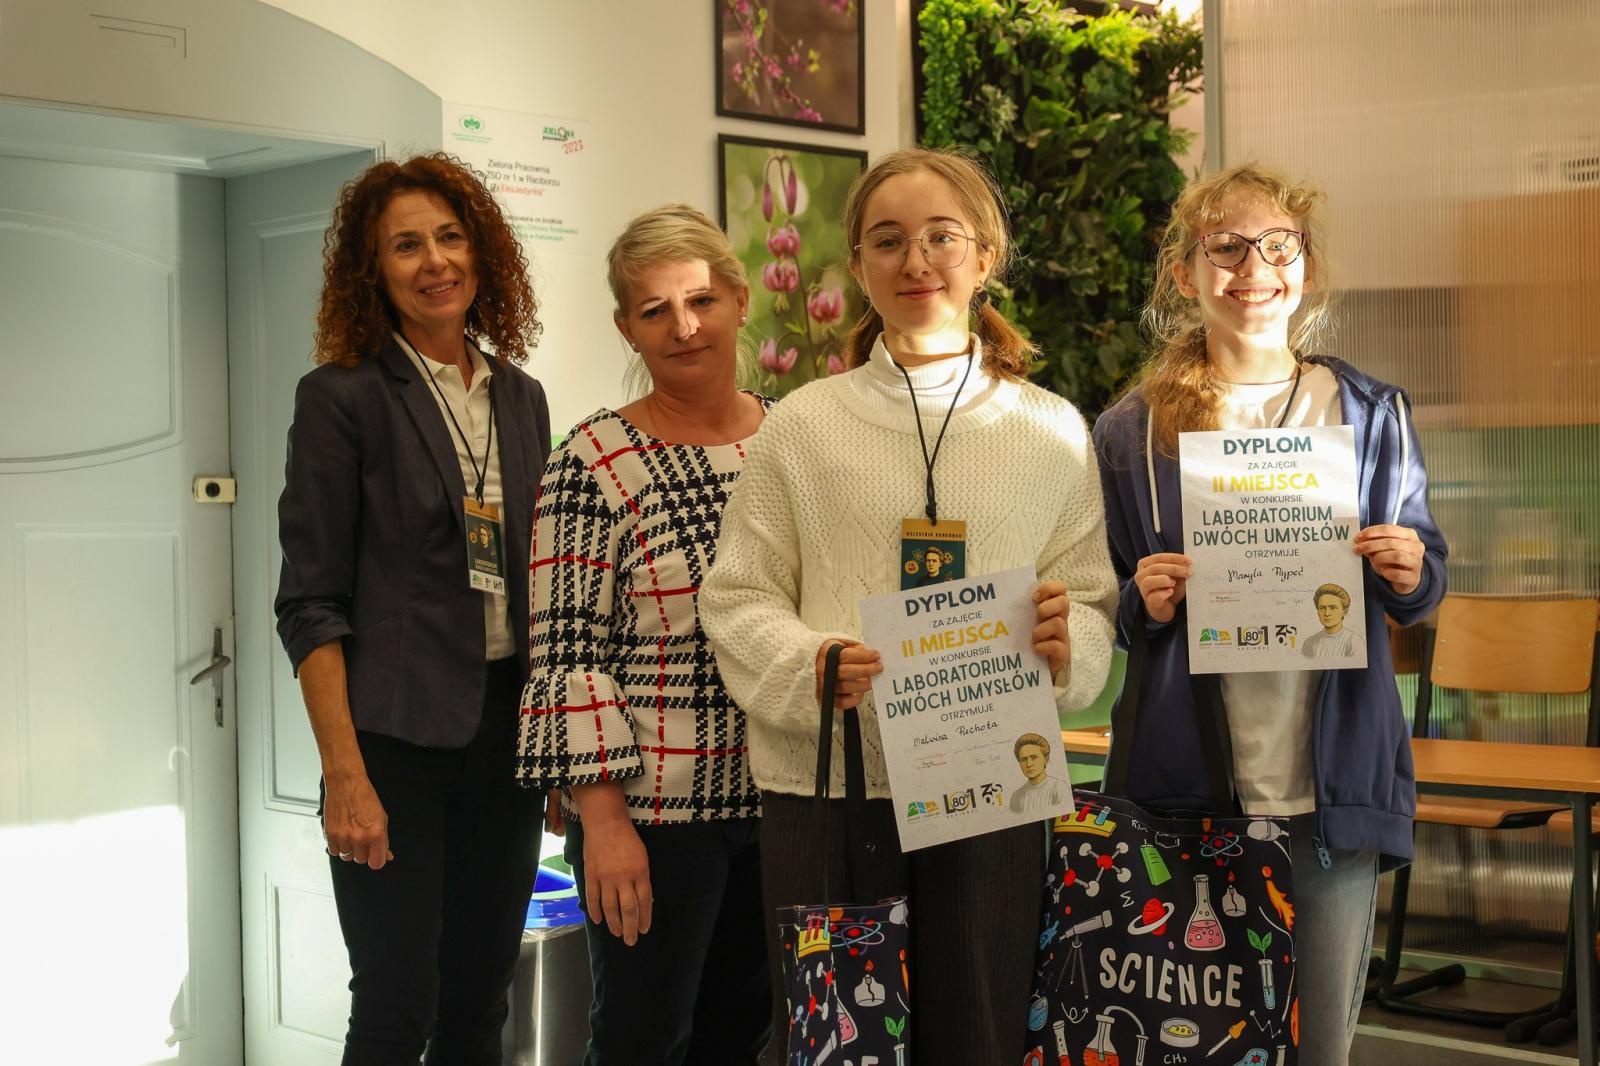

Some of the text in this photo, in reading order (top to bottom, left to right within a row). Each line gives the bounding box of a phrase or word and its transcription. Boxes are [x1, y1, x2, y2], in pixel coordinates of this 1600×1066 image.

[562, 140, 583, 154] 2023
[488, 160, 550, 174] Zielona Pracownia
[1223, 436, 1312, 455] DYPLOM
[1248, 461, 1297, 470] ZA ZAJĘCIE
[1212, 473, 1319, 493] II MIEJSCA
[1240, 495, 1303, 504] W KONKURSIE
[1202, 506, 1332, 526] LABORATORIUM
[1193, 522, 1349, 547] DWÓCH UMYSŁÓW
[1245, 549, 1300, 559] OTRZYMUJE
[905, 583, 996, 616] DYPLOM
[932, 611, 983, 628] ZA ZAJĘCIE
[902, 620, 1009, 657] II MIEJSCA
[929, 645, 991, 666] W KONKURSIE
[892, 652, 1022, 695] LABORATORIUM
[885, 669, 1040, 719] DWÓCH UMYSŁÓW
[941, 704, 994, 722] OTRZYMUJE
[1100, 947, 1243, 1008] SCIENCE
